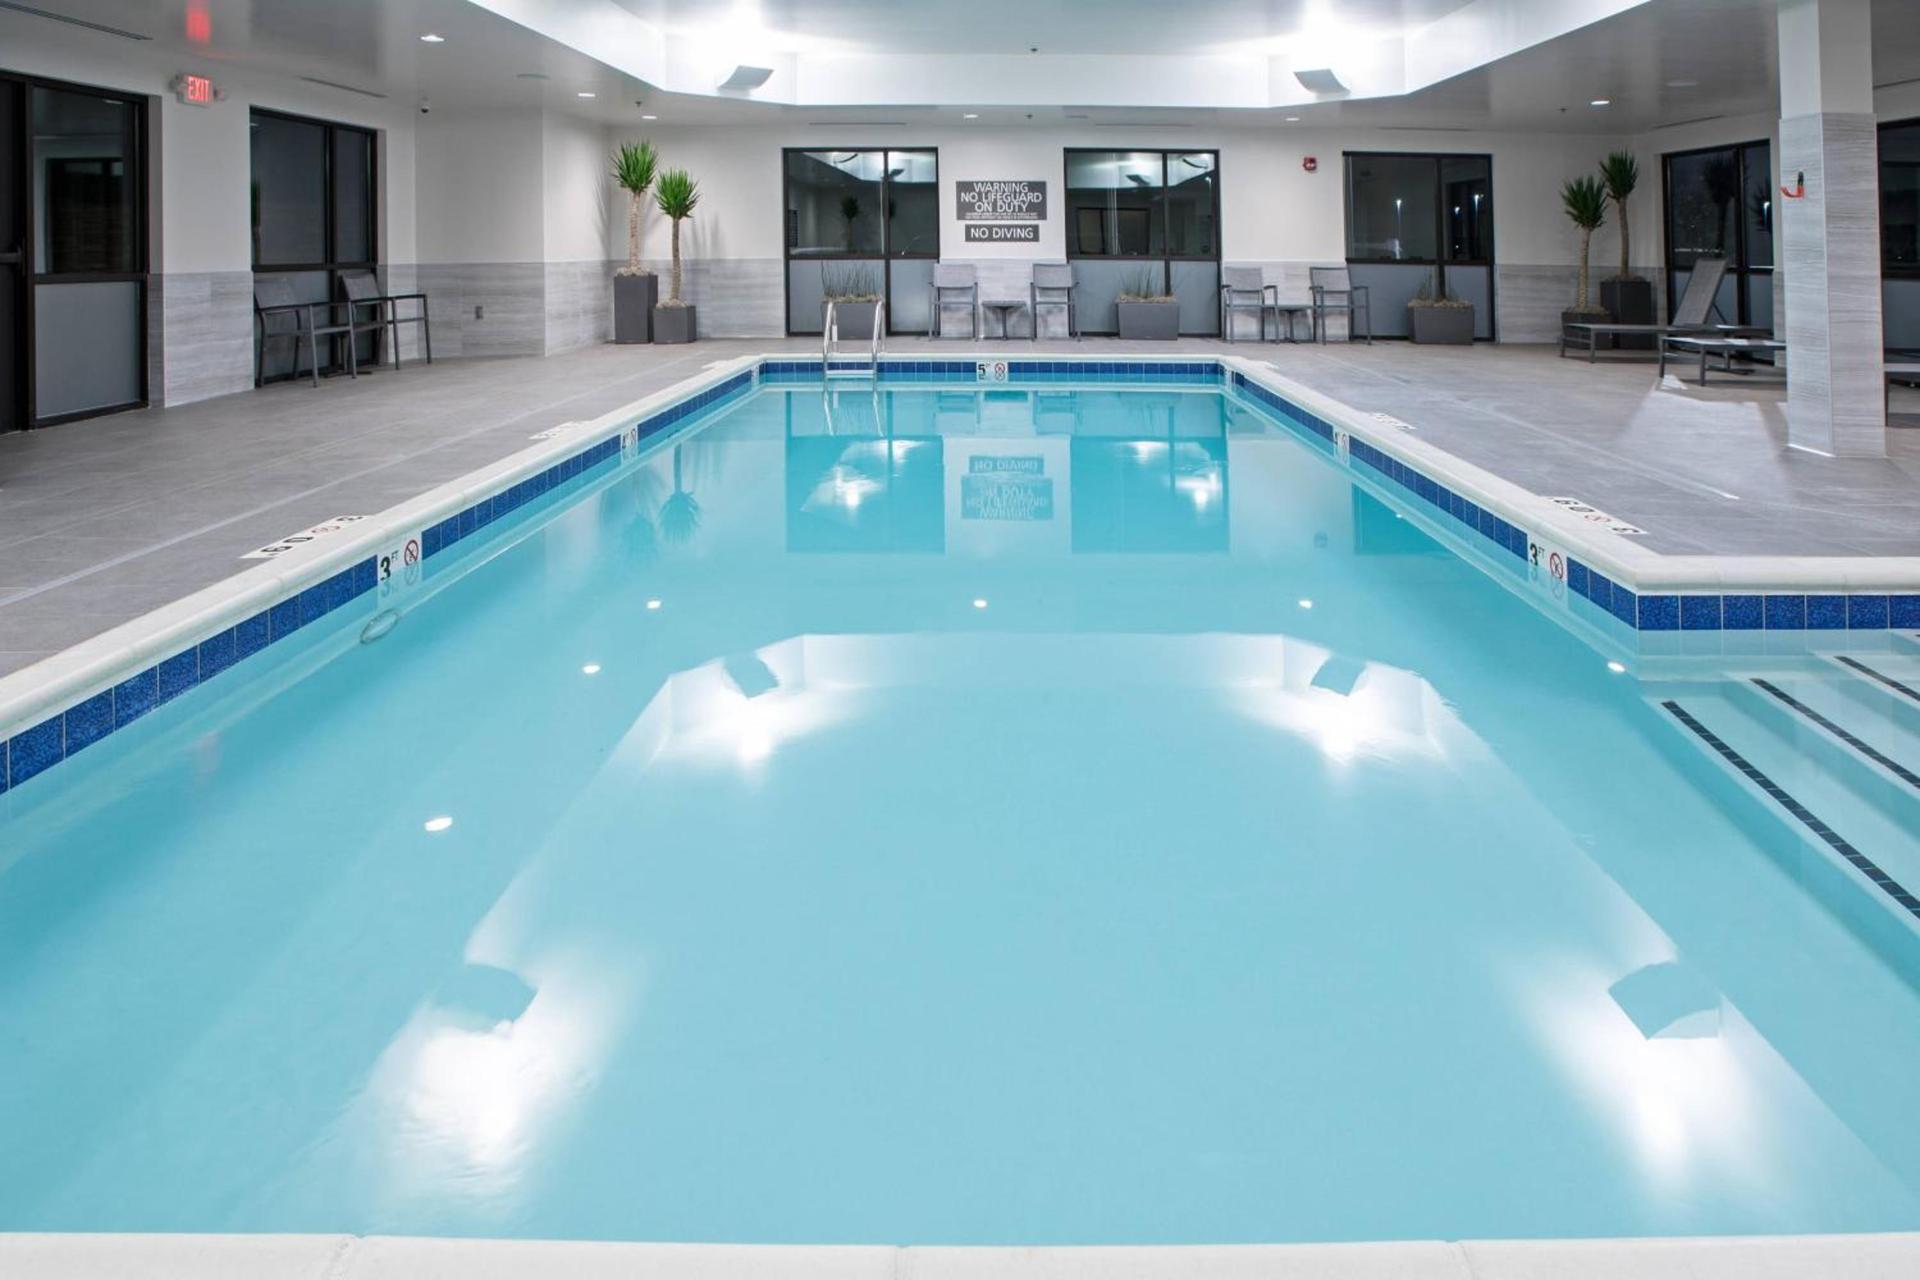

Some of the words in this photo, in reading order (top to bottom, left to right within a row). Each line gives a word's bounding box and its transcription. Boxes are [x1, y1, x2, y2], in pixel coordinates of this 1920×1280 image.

[188, 76, 209, 102] EXIT
[974, 182, 1028, 192] WARNING
[961, 192, 978, 202] NO
[983, 192, 1042, 202] LIFEGUARD
[975, 202, 992, 212] ON
[997, 202, 1028, 212] DUTY
[971, 227, 989, 238] NO
[993, 227, 1034, 238] DIVING
[1530, 542, 1538, 566] 3
[380, 556, 391, 580] 3
